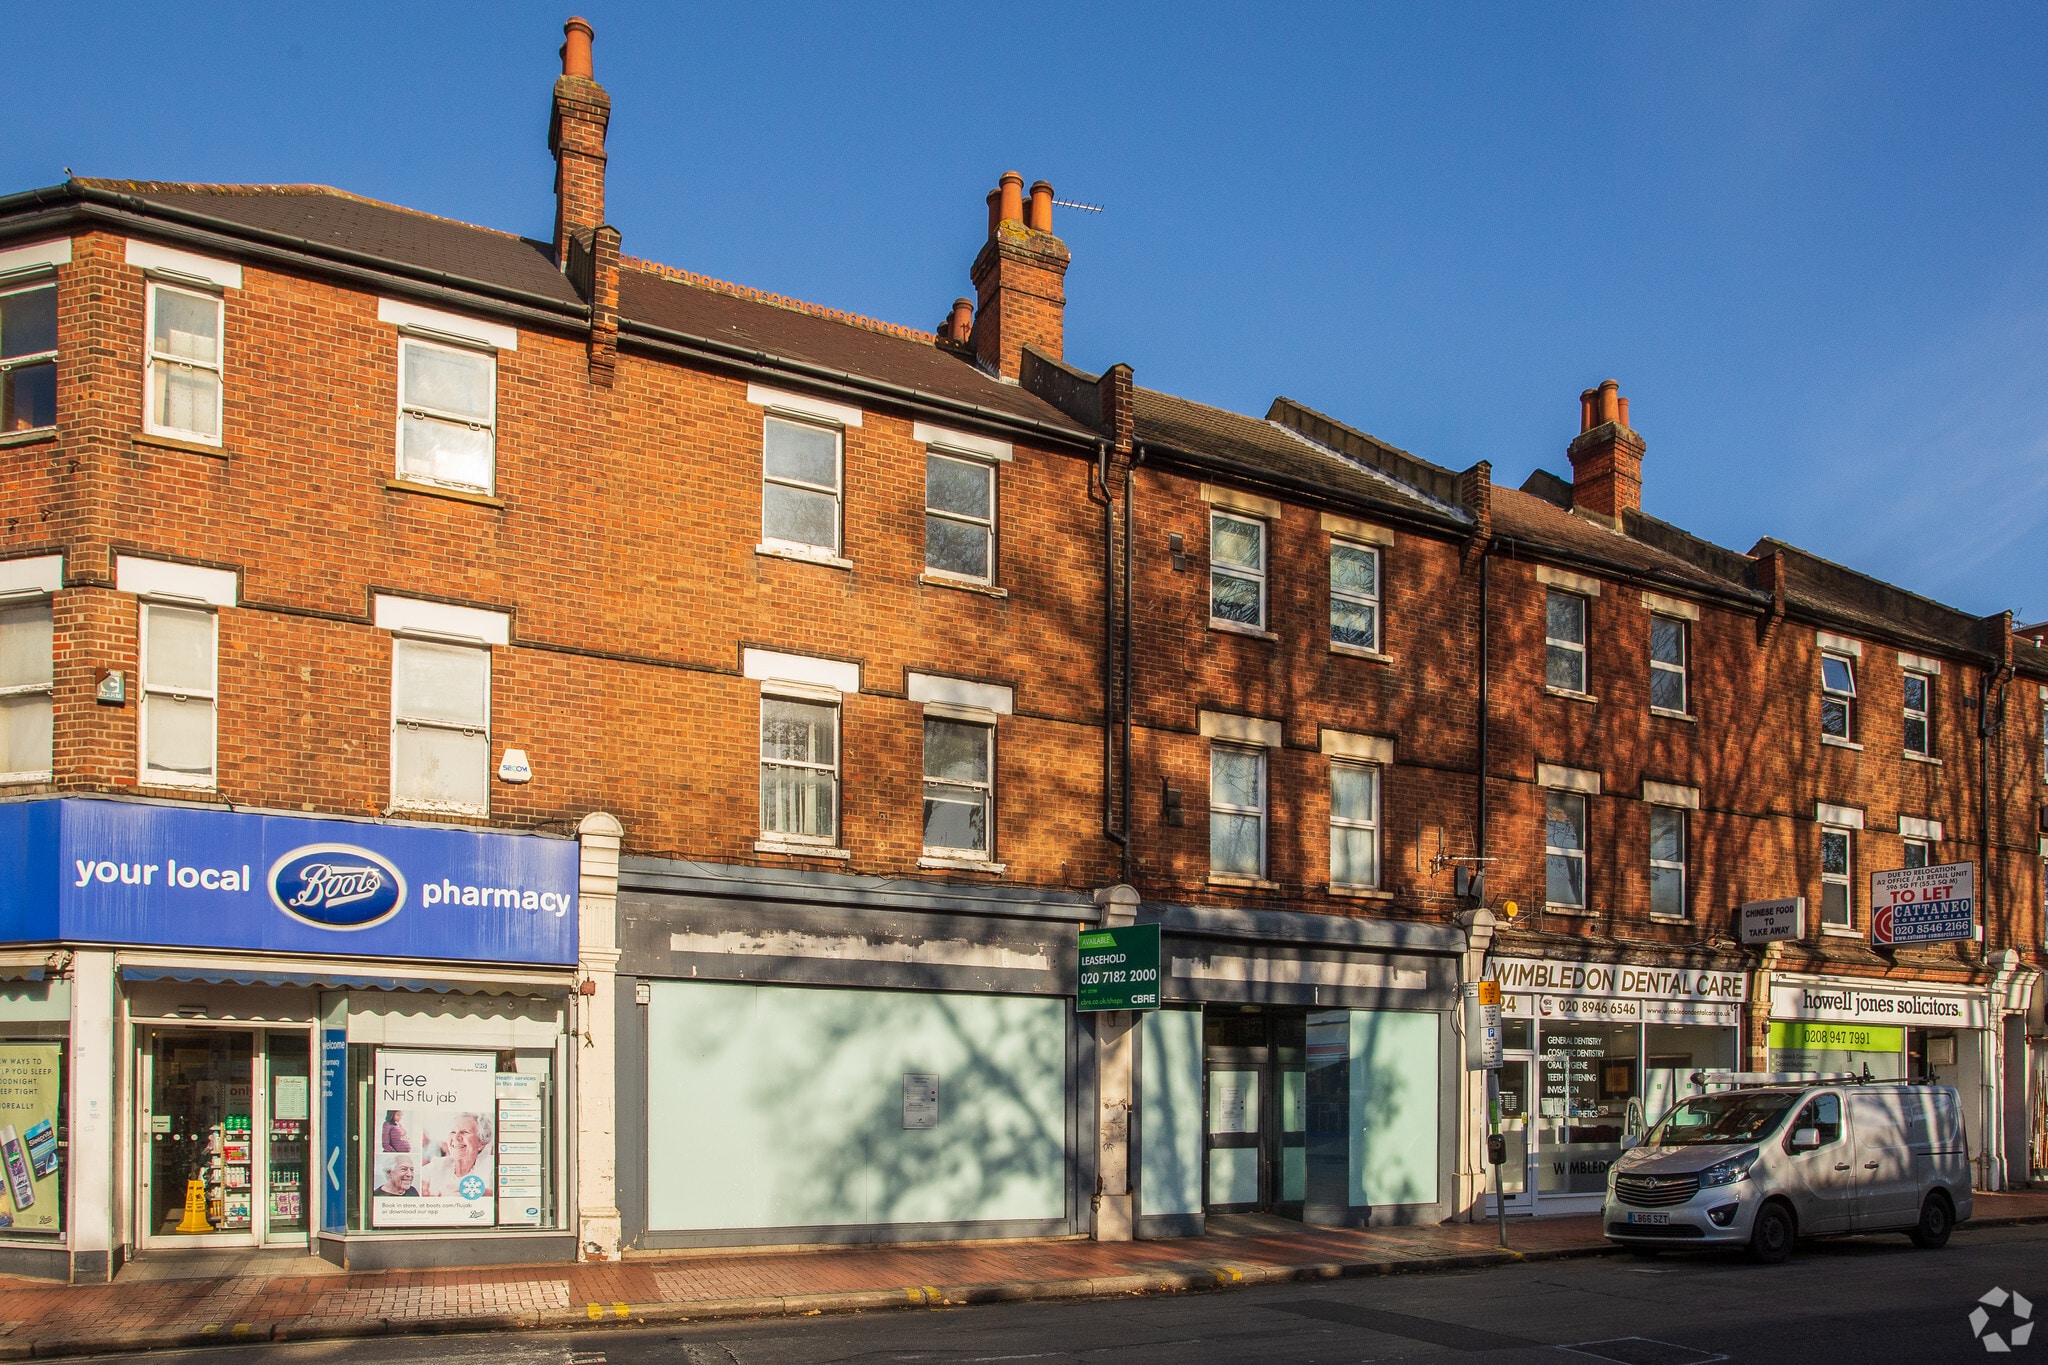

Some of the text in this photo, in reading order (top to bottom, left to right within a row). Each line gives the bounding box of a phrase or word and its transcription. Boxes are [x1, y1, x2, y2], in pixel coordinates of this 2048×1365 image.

[502, 764, 528, 773] SECOM
[75, 858, 251, 892] your local
[1913, 866, 1957, 876] RELOCATION
[288, 864, 382, 909] Boots
[422, 879, 570, 918] pharmacy
[1890, 885, 1953, 904] TO LET
[1745, 905, 1795, 918] CHINESE FOOD
[1894, 900, 1969, 918] CATTANEO
[1764, 918, 1775, 926] TO
[1894, 913, 1970, 923] COMMERCIAL
[1749, 926, 1790, 937] TAKE AWAY
[1895, 921, 1969, 936] 020 8546 2166
[1081, 936, 1111, 946] AVAILABLE
[1081, 953, 1127, 966] LEASEHOLD
[1081, 968, 1157, 985] 020 7182 2000
[1492, 962, 1743, 998] WIMBLEDON DENTAL CARE
[1130, 994, 1156, 1004] CBRE
[1802, 989, 1963, 1017] howell jones solicitors.
[1558, 1000, 1579, 1013] 020
[1582, 1001, 1608, 1014] 8946
[1610, 1003, 1636, 1015] 6546
[1547, 1036, 1602, 1046] GENERAL DENTISTRY
[1804, 1030, 1870, 1045] 0208 947 7991
[1547, 1048, 1605, 1058] COSMETIC DENTISTRY
[1547, 1061, 1563, 1070] ORAL
[384, 1067, 427, 1087] Free
[1547, 1073, 1563, 1082] TEETH
[229, 1086, 252, 1098] onl
[383, 1089, 415, 1102] NHS
[417, 1090, 433, 1103] flu
[1547, 1085, 1579, 1094] INVISAGN
[1553, 1161, 1611, 1175] WMBLED
[1633, 1214, 1668, 1224] LB66 SZT
